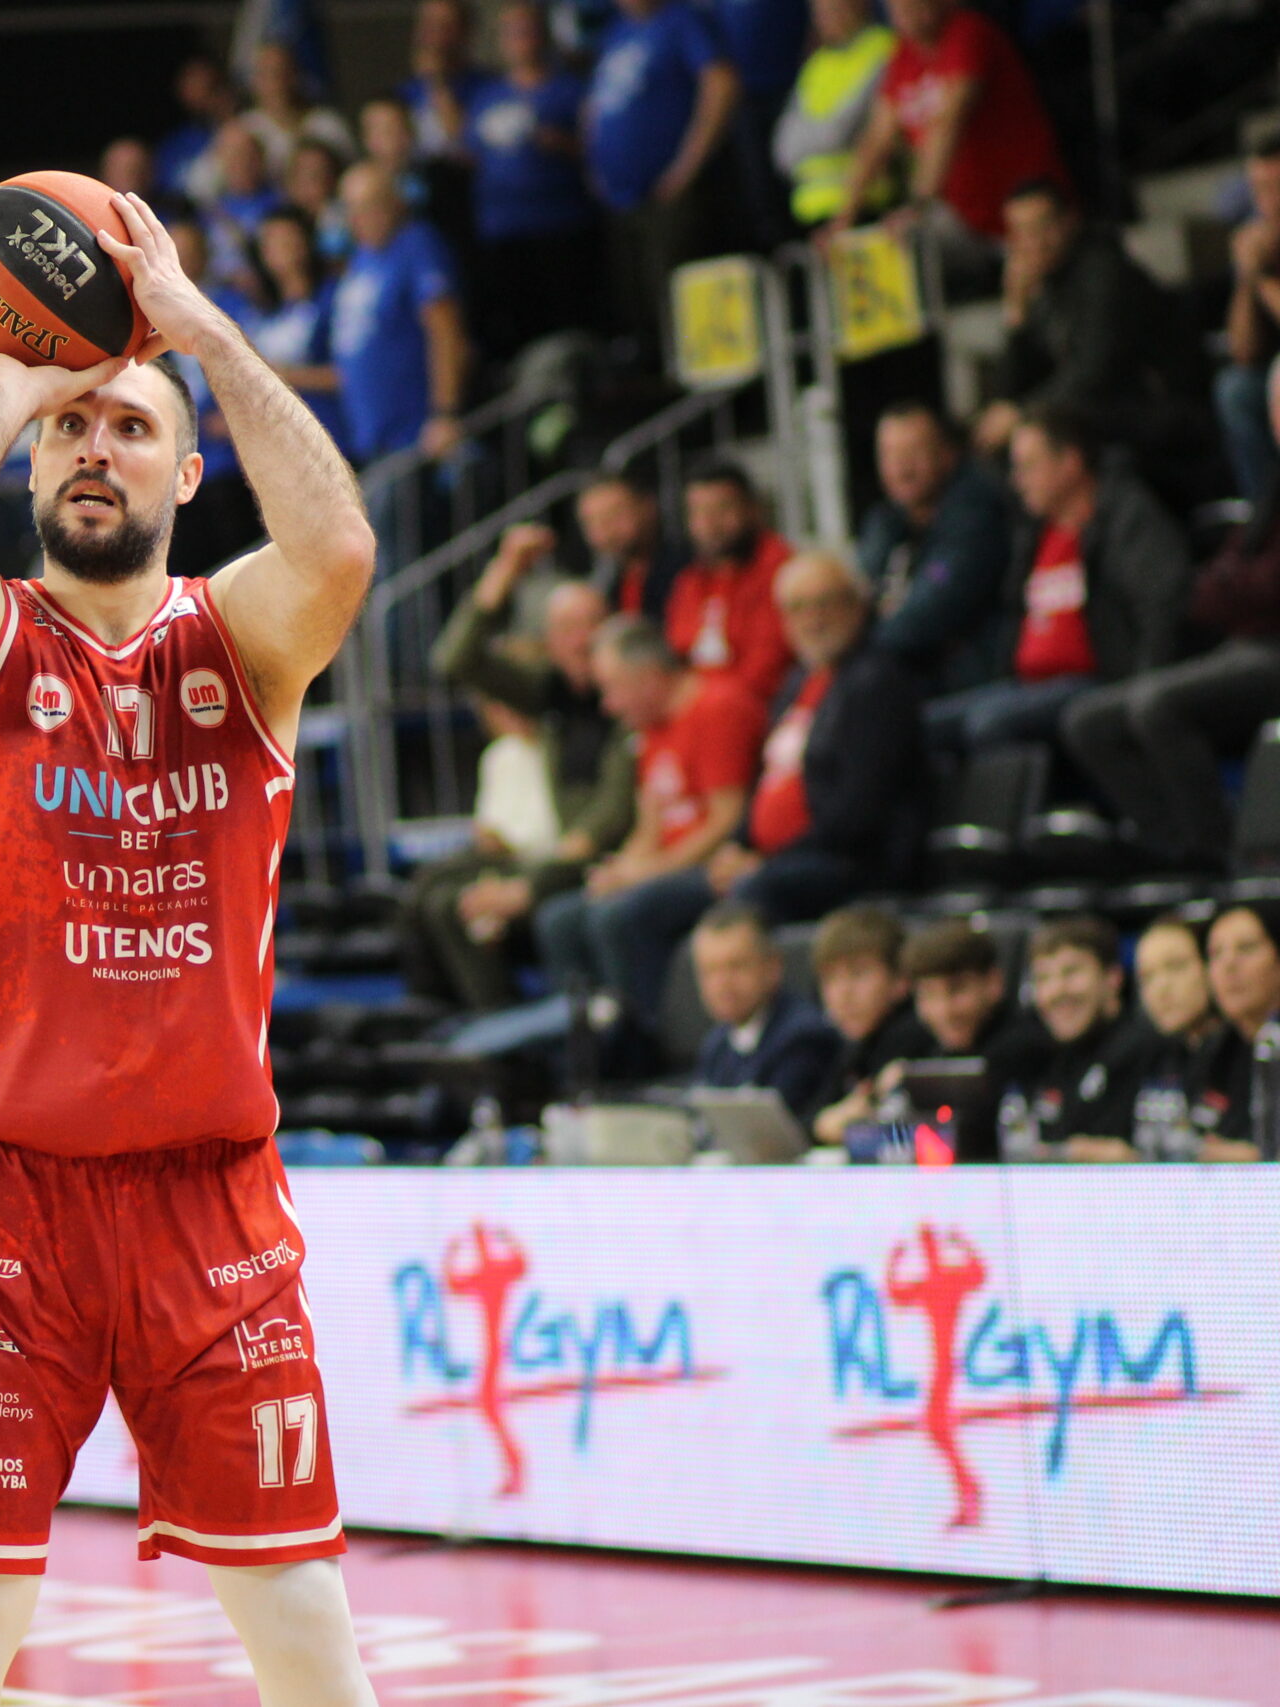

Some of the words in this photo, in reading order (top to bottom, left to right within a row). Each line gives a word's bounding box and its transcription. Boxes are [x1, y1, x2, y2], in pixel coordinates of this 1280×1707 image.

[21, 241, 77, 300] betsafe
[32, 209, 97, 288] LKL
[102, 684, 156, 761] 17
[121, 830, 162, 850] BET
[65, 896, 129, 913] FLEXIBLE
[65, 921, 213, 965] UTENOS
[251, 1393, 318, 1488] 17
